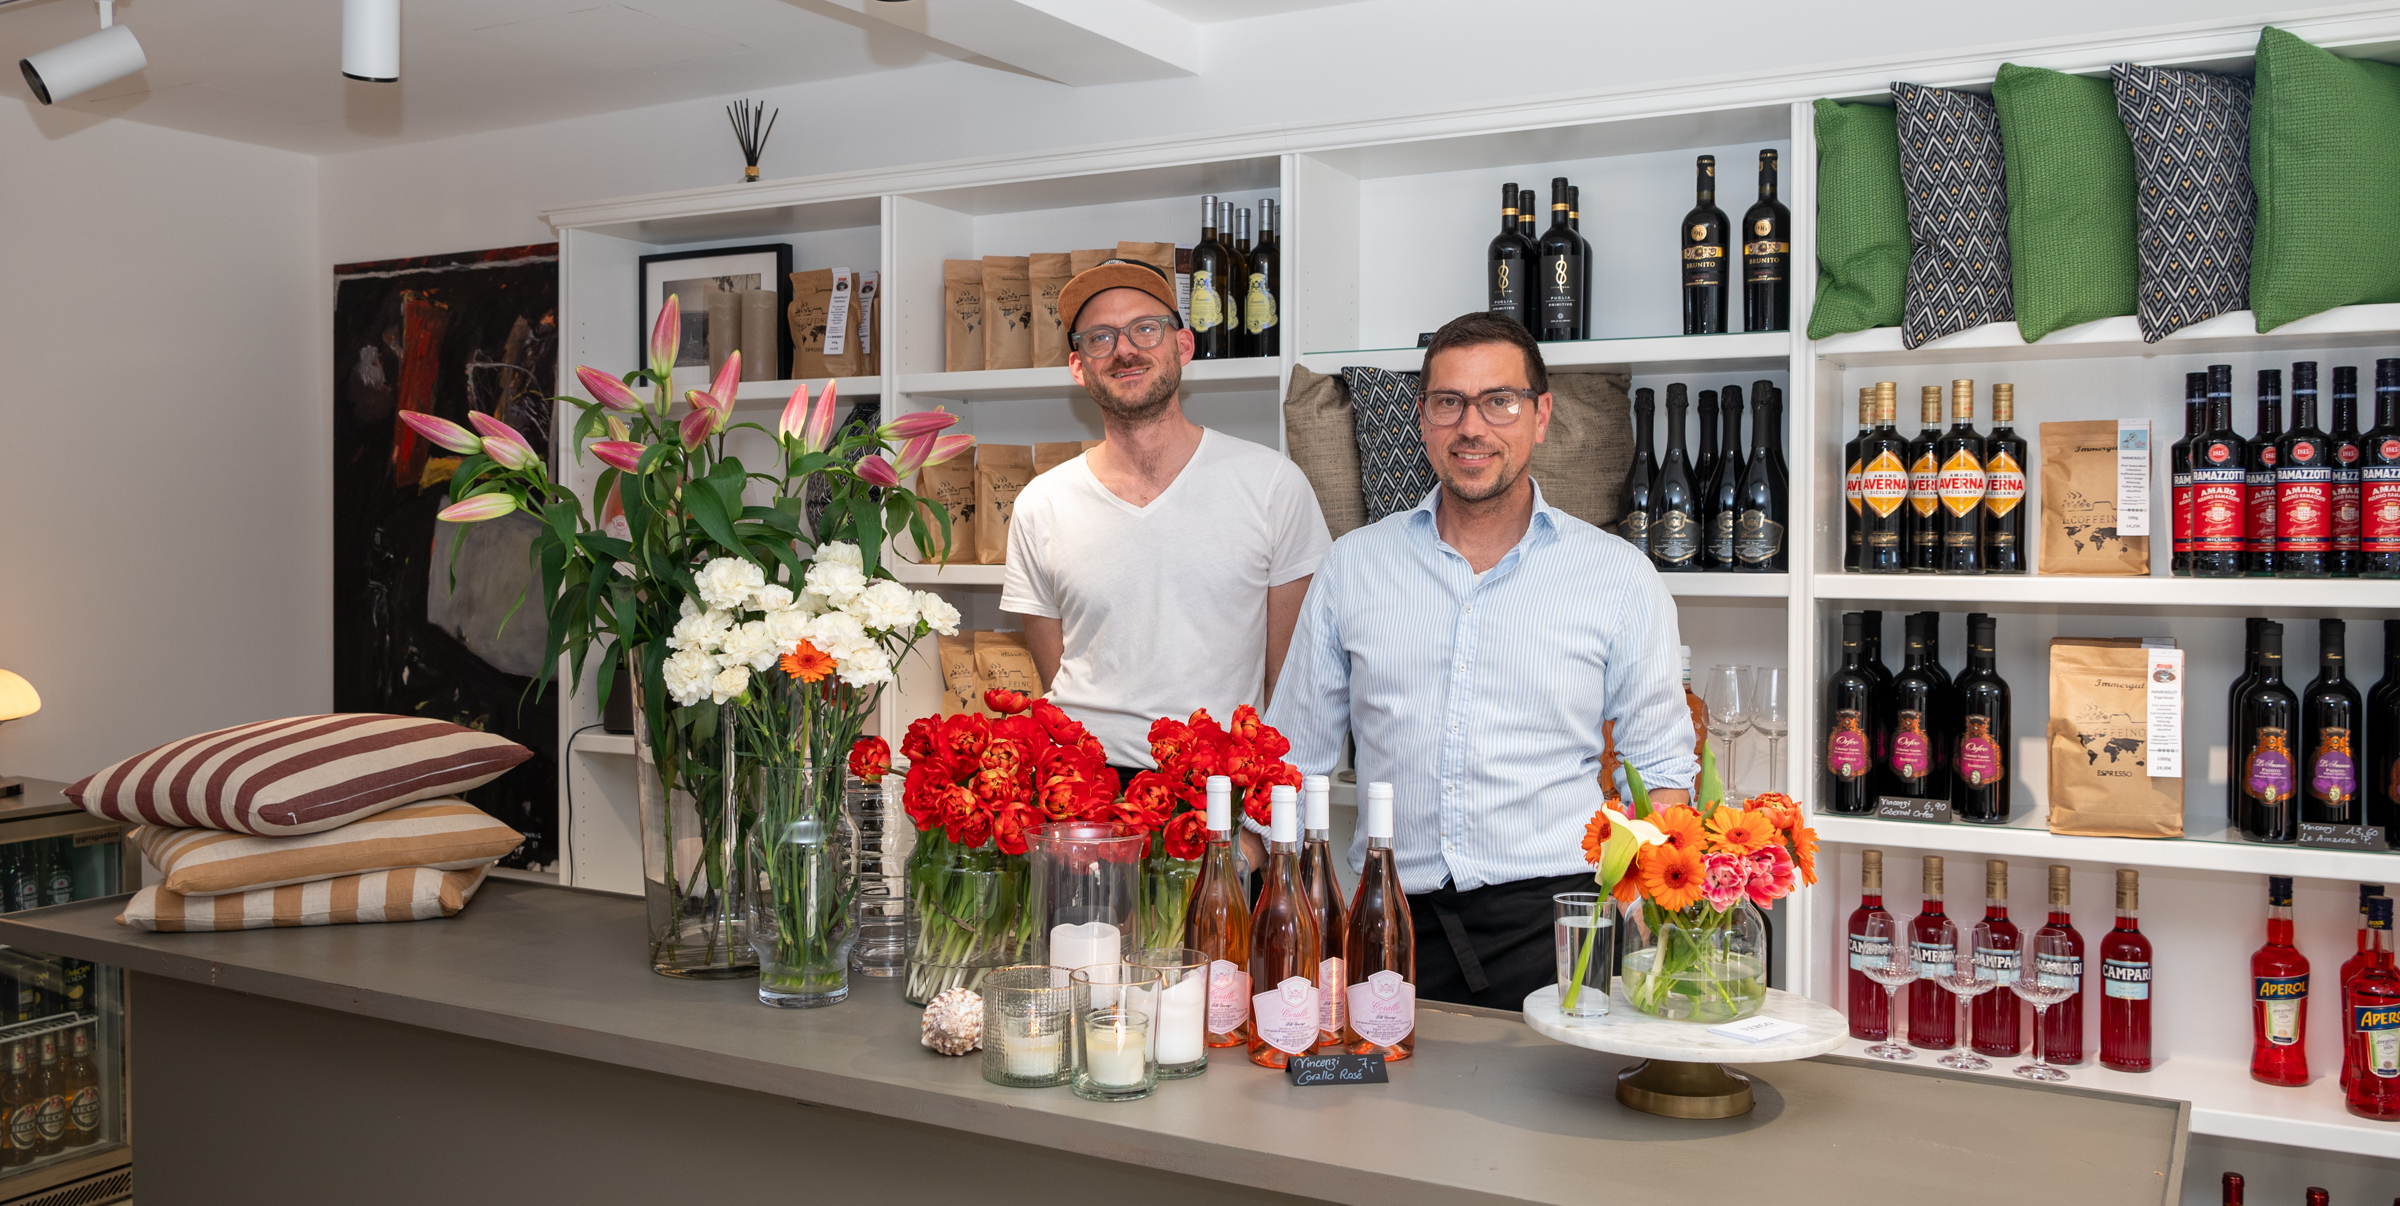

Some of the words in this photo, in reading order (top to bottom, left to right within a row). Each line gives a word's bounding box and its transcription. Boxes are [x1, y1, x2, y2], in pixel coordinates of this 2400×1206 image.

[1686, 261, 1716, 269] BRUNITO
[1749, 257, 1780, 265] BRUNITO
[2193, 470, 2245, 481] RAMAZZOTTI
[2277, 469, 2331, 480] RAMAZZOTTI
[1863, 478, 1907, 490] AVERNA
[1938, 477, 1985, 490] AVERNA
[2200, 486, 2237, 497] AMARO
[2285, 485, 2322, 496] AMARO
[1836, 735, 1859, 747] Orfeo
[1897, 736, 1920, 747] Orfeo
[1965, 742, 1989, 754] Orfeo
[2097, 769, 2133, 777] ESPRESSO
[1923, 801, 1947, 812] 6,90
[75, 830, 119, 844] ggmgastro
[2299, 833, 2313, 842] Le
[2102, 964, 2151, 981] CAMPARI
[2260, 981, 2306, 996] APEROL
[1294, 1057, 1340, 1071] Vincenzi
[1297, 1070, 1335, 1085] Corallo
[1340, 1068, 1363, 1080] Rosé
